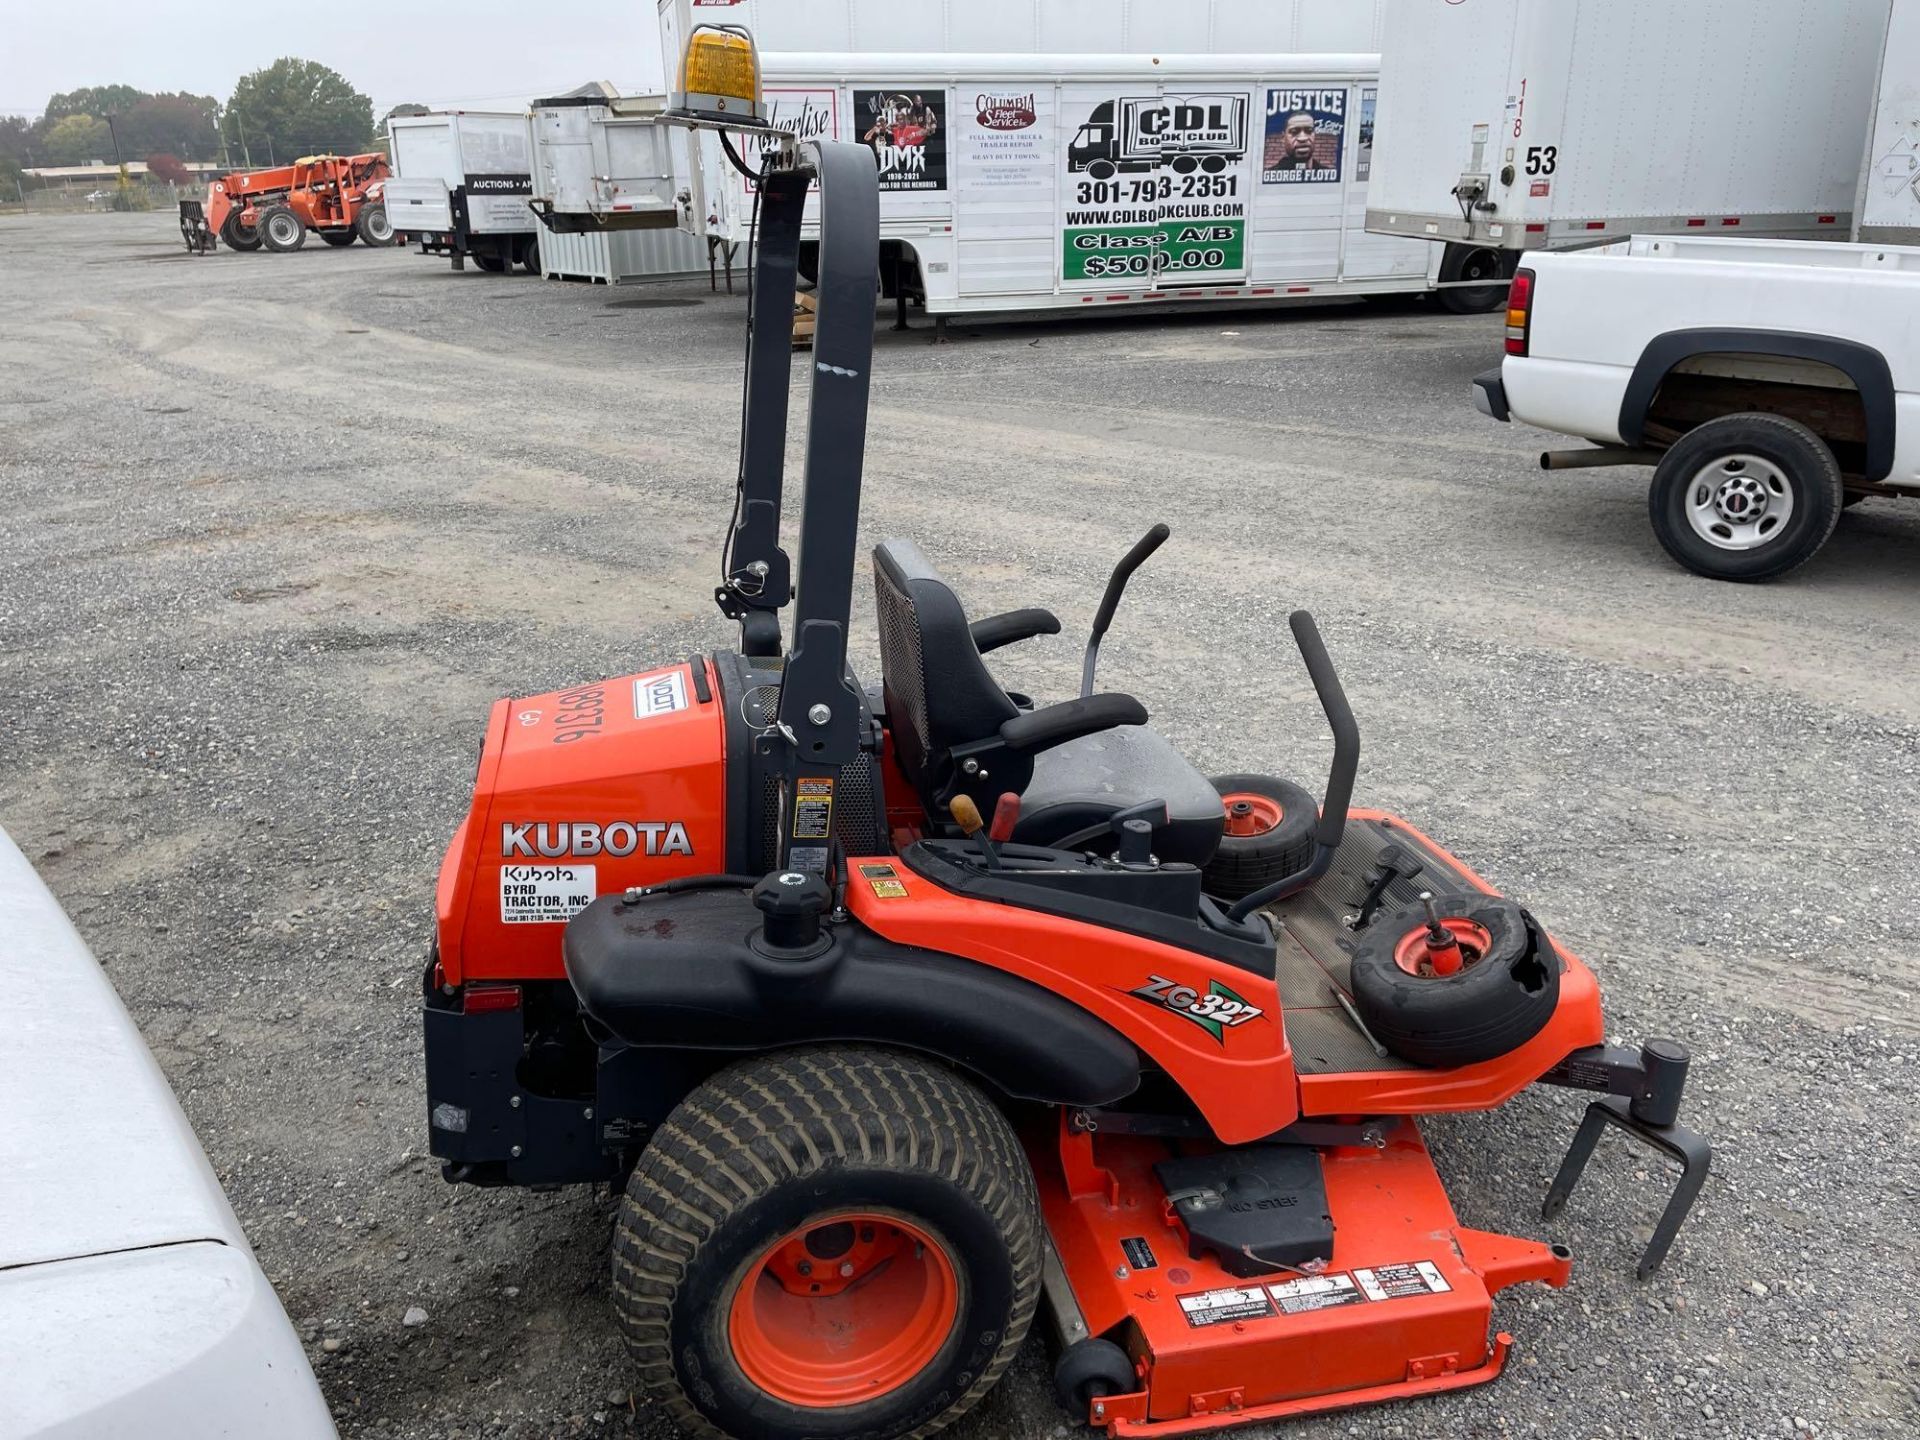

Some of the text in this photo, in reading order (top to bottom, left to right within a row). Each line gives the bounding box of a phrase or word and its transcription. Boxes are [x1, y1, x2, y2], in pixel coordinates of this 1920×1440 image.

[976, 93, 1035, 113] COLUMBIA
[1267, 89, 1343, 116] JUSTICE
[984, 109, 1019, 127] Service
[994, 109, 1023, 119] Fleet
[1140, 105, 1228, 135] CDL
[1138, 133, 1228, 145] BOOK CLUB
[879, 145, 926, 174] DMX
[1525, 146, 1558, 175] 53
[473, 180, 532, 189] AUCTIONS AP
[887, 172, 920, 180] 1970-2021
[890, 181, 901, 189] FOR
[911, 180, 937, 188] MEMORIES
[1263, 169, 1337, 182] GEORGE FLOYD
[1077, 174, 1237, 204] 301-793-2351
[1066, 203, 1243, 225] WWW.CDLBOOKCLUB.COM
[1074, 226, 1235, 250] Class A/B
[1084, 249, 1225, 277] $500.00
[645, 674, 676, 711] VDOT
[553, 684, 605, 744] N89376
[501, 821, 695, 857] KUBOTA
[505, 866, 574, 882] Kubota
[504, 885, 536, 896] BYRD
[504, 895, 589, 908] TRACTOR, INC
[1131, 974, 1264, 1027] ZG327
[1228, 1201, 1253, 1214] NO
